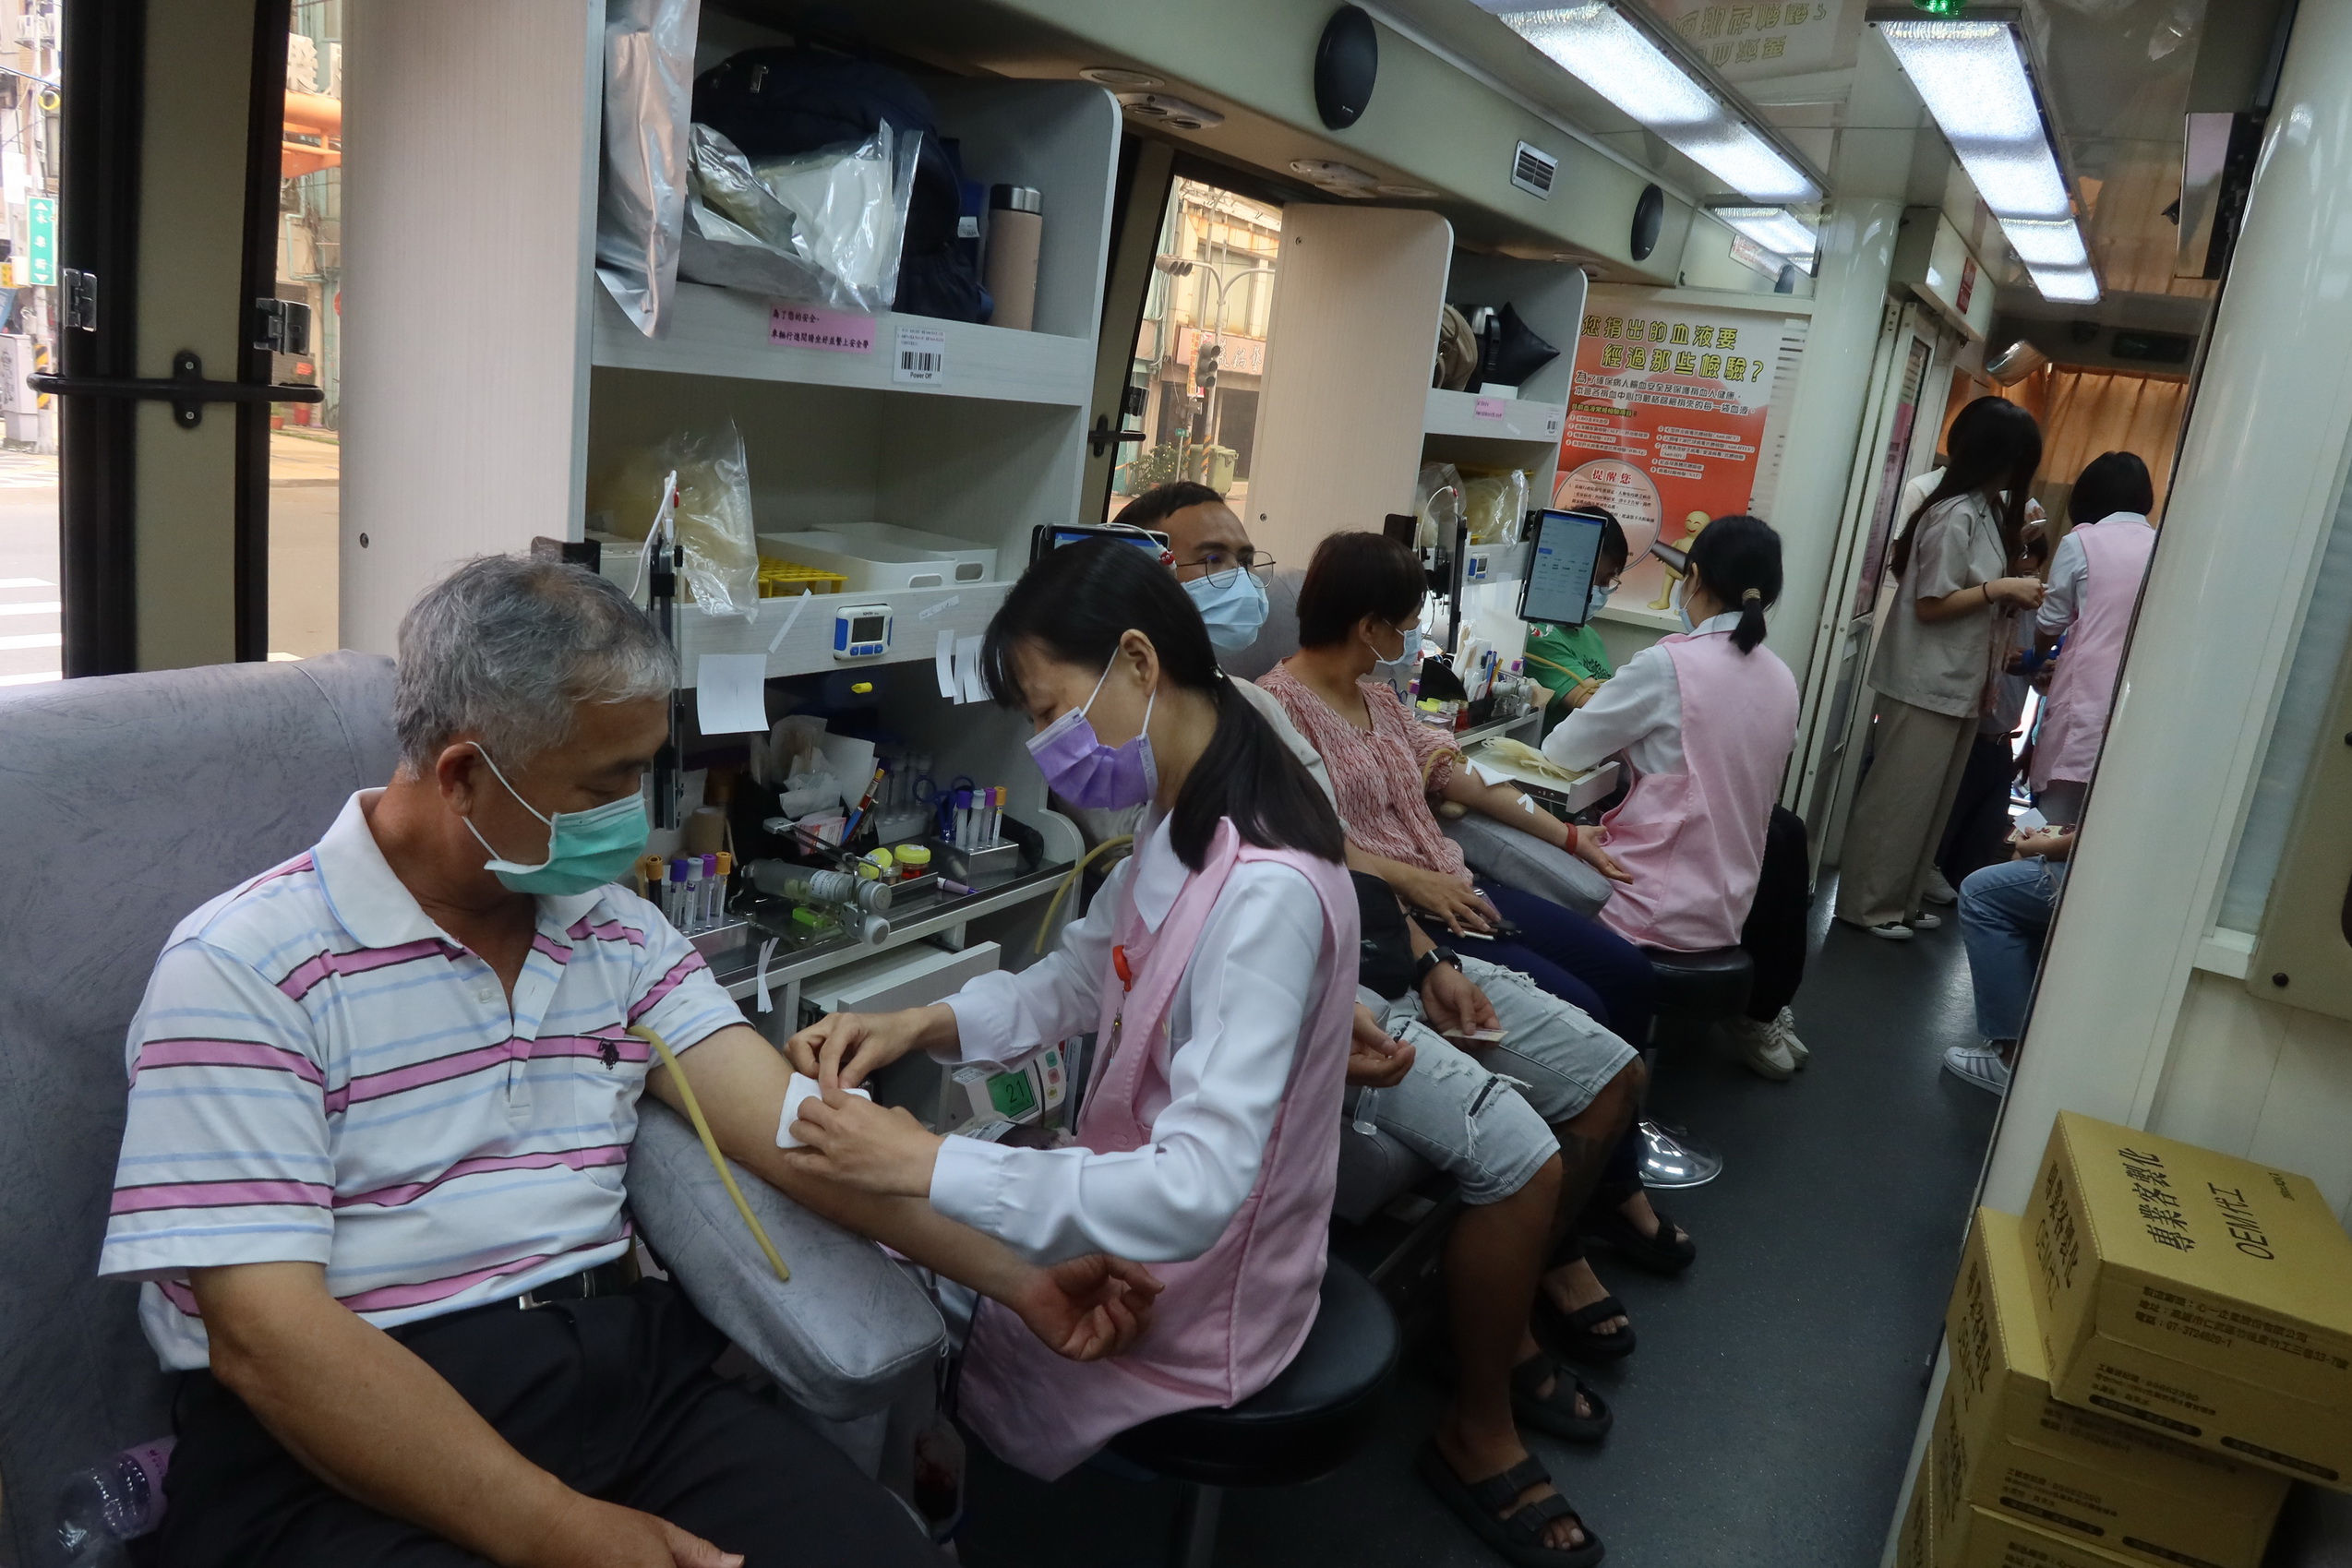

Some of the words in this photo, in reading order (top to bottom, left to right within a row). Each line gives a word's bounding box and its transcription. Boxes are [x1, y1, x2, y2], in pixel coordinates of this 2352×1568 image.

[1581, 315, 1738, 350] 您捐出的血液要
[910, 371, 924, 379] Power
[1592, 469, 1632, 484] 提醒您
[1005, 1080, 1026, 1104] 21
[2118, 1147, 2196, 1253] 專業客製化
[2207, 1181, 2274, 1261] OEM代工
